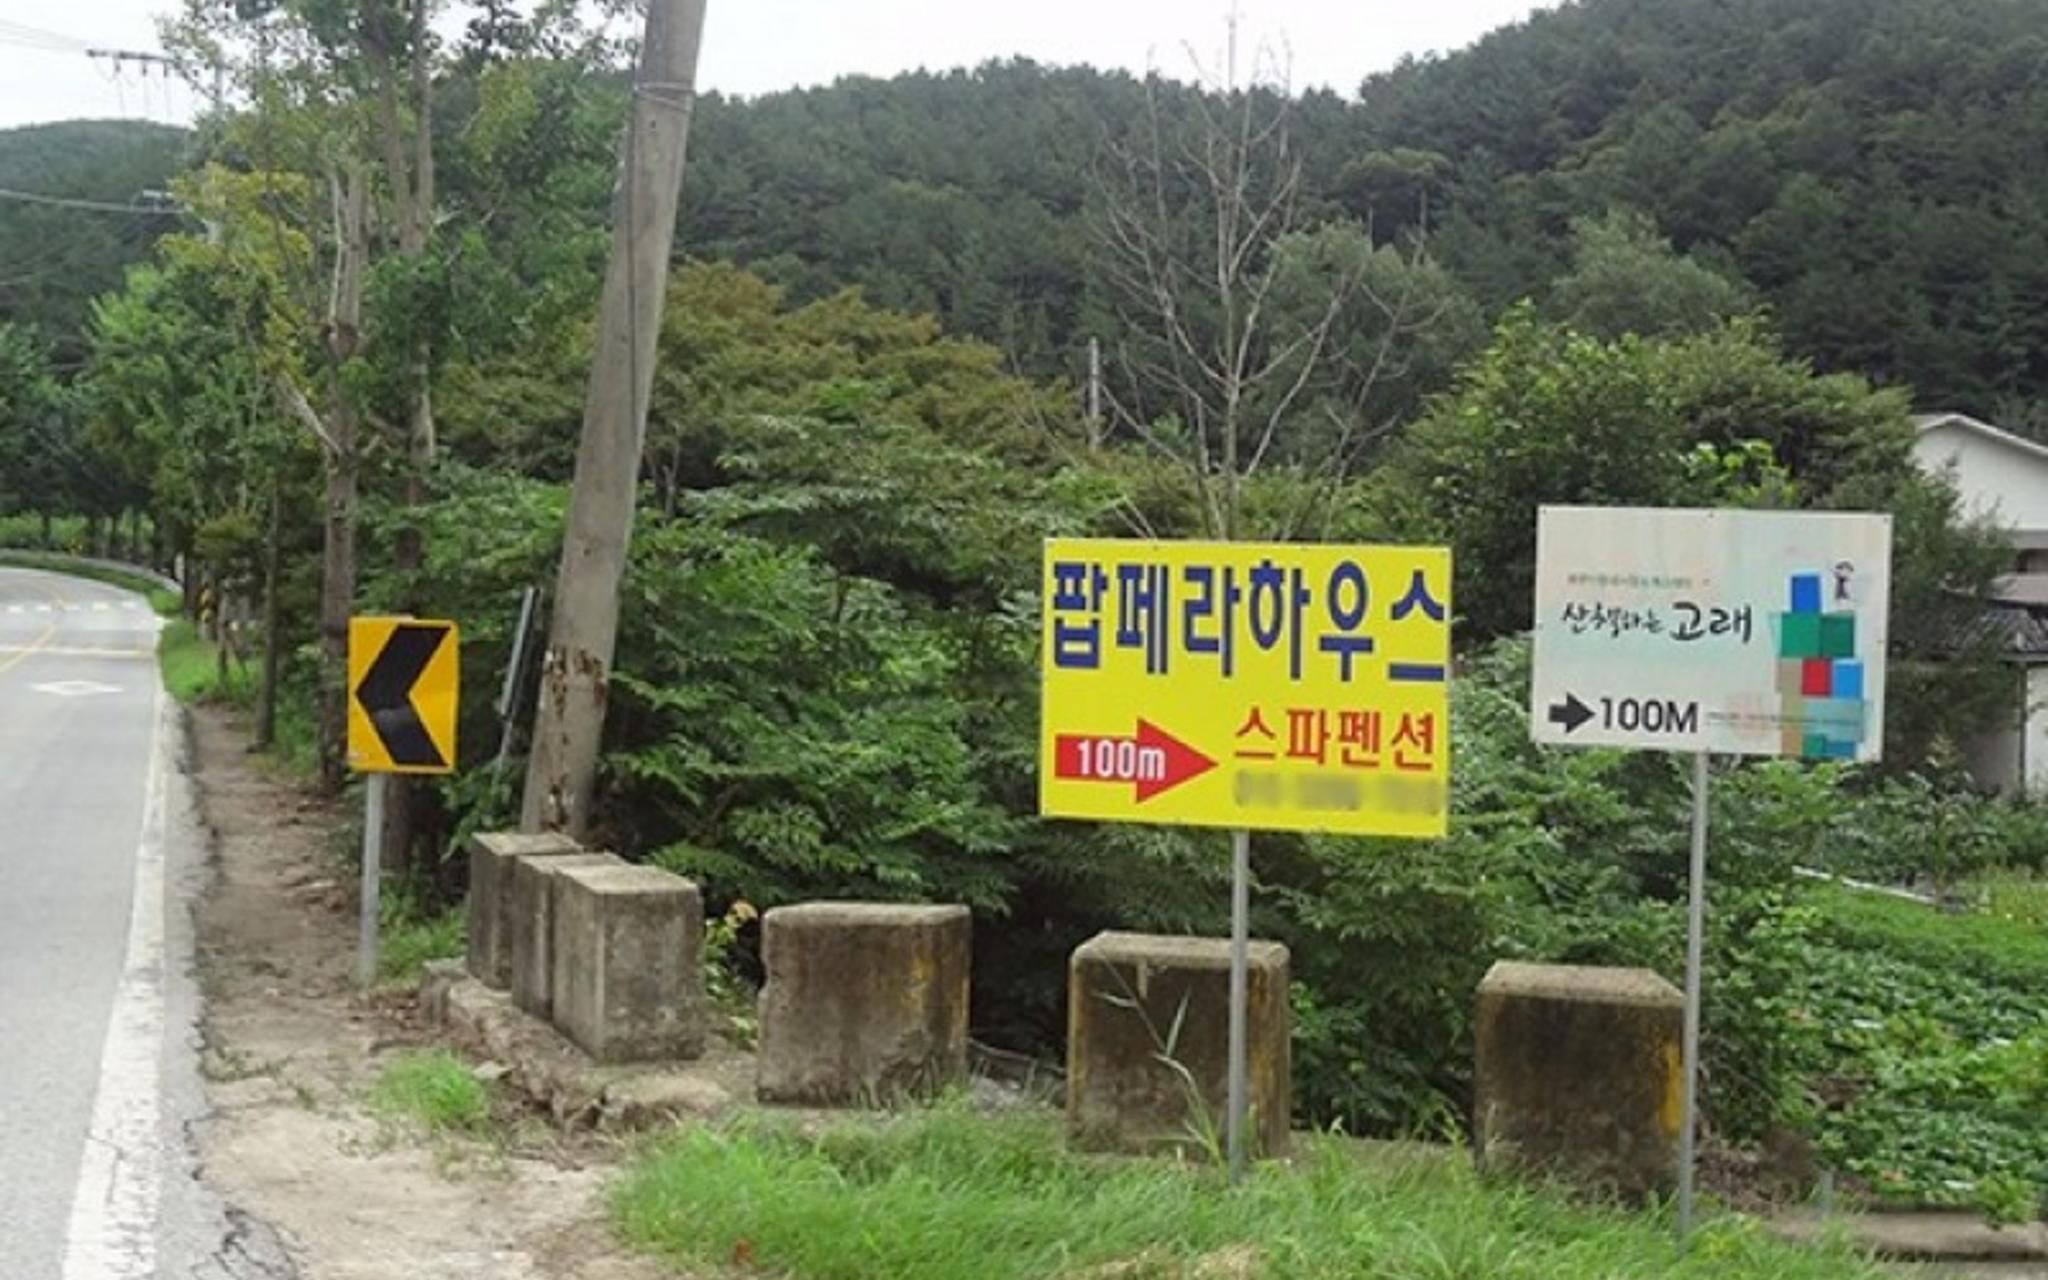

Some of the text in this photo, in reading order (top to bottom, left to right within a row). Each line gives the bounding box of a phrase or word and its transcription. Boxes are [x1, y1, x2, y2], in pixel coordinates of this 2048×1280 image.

[1053, 559, 1446, 682] 팝페라하우스
[1670, 601, 1753, 644] 고래
[1600, 698, 1699, 733] 100M
[1078, 739, 1166, 781] 100m
[1234, 706, 1434, 771] 스파펜션
